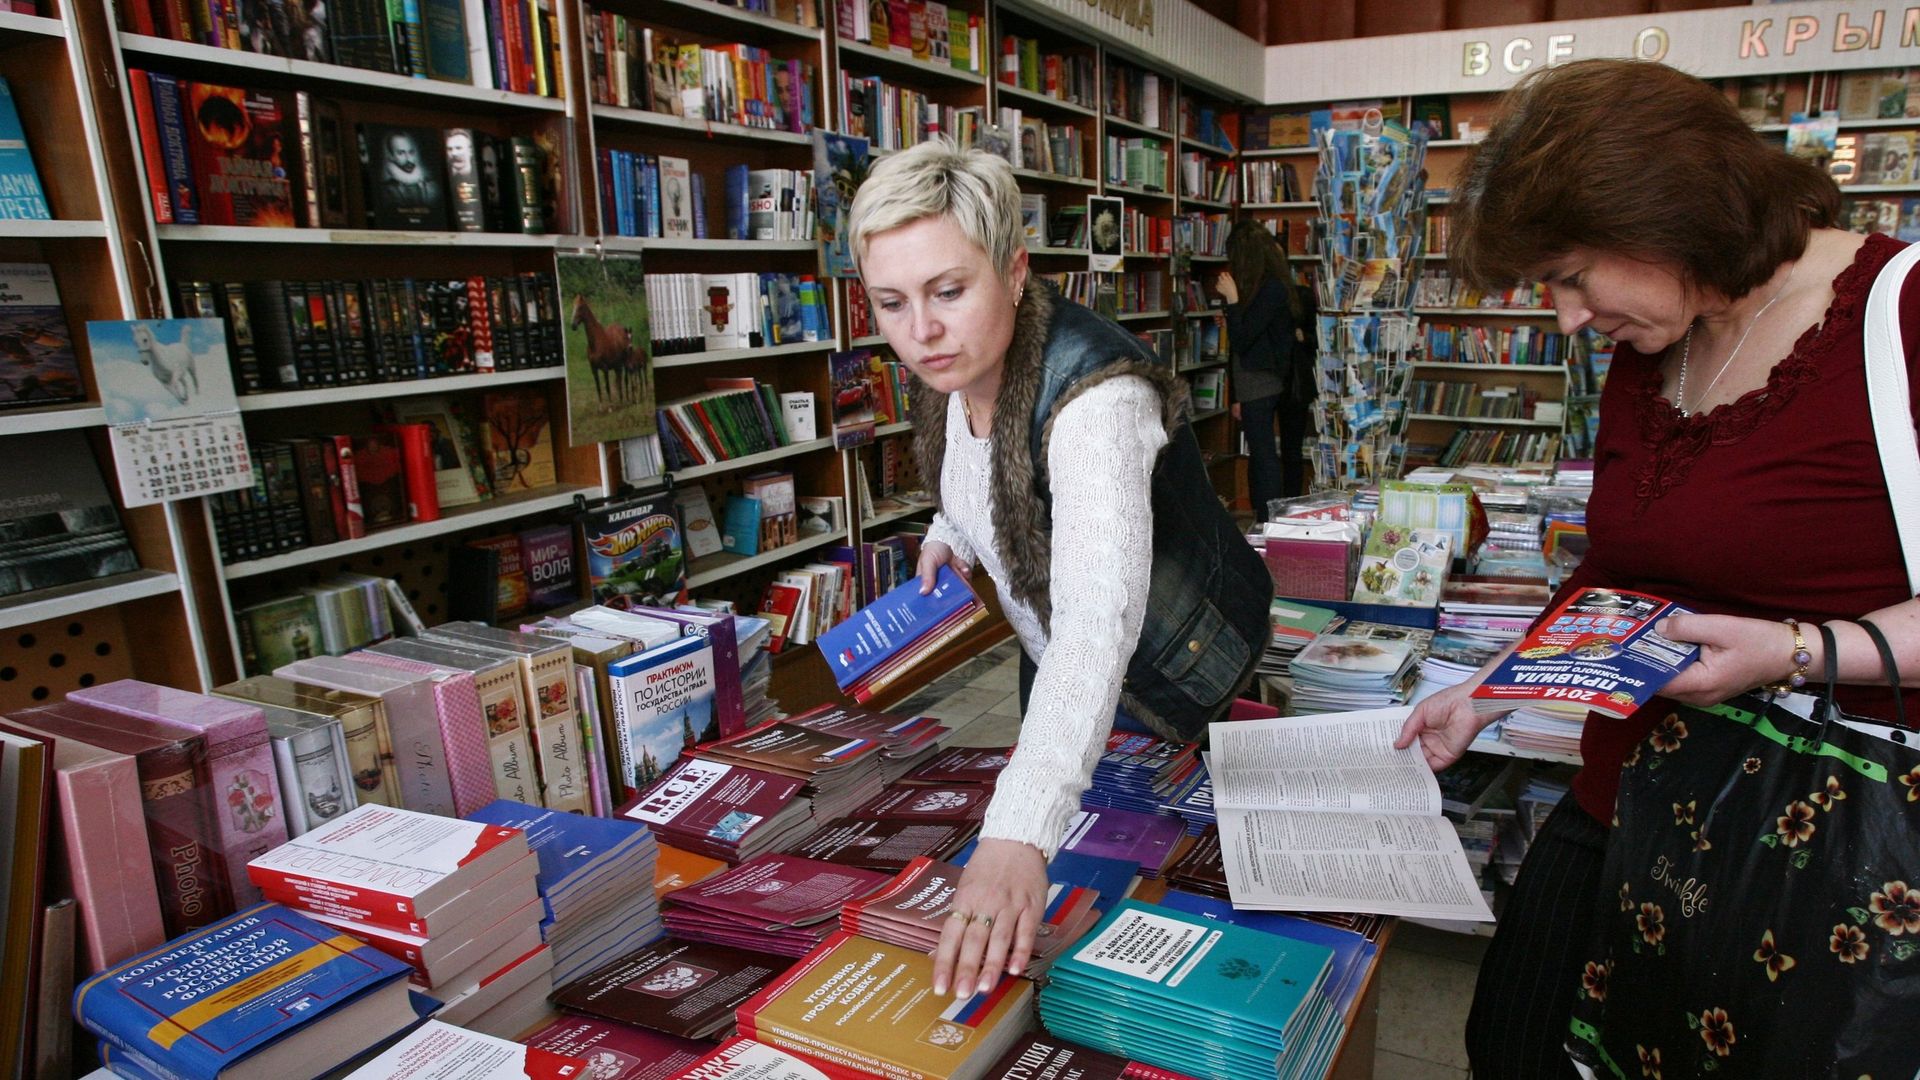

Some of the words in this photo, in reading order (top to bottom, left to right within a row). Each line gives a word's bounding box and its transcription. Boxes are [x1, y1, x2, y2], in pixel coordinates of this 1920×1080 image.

[1463, 33, 1575, 77] ВСЕ
[1634, 26, 1669, 63] О
[750, 200, 772, 212] SHO
[148, 467, 160, 475] 13
[163, 465, 176, 473] 14
[179, 462, 190, 471] 15
[208, 458, 219, 466] 17
[150, 455, 158, 464] 6
[205, 447, 217, 455] 10
[149, 478, 163, 487] 20
[165, 476, 177, 484] 21
[181, 473, 193, 481] 22
[196, 471, 208, 479] 23
[210, 468, 222, 477] 24
[152, 489, 165, 498] 27
[183, 484, 195, 492] 29
[198, 481, 210, 490] 30
[213, 479, 225, 487] 31
[608, 504, 653, 522] КАЛЕНДАР
[531, 545, 558, 564] МИР
[532, 557, 570, 582] ВОЛЯ
[634, 688, 653, 703] ПО
[655, 667, 706, 694] ИСТОРИИ
[646, 661, 694, 685] ПРАКТИКУМ
[1513, 672, 1619, 691] ПРАВИЛА
[1571, 666, 1645, 687] ДОРОЖНОГО
[637, 690, 682, 712] ГОСУДАРСТВА
[688, 680, 708, 692] ПРАВА
[656, 695, 692, 715] РОССИИ
[1543, 687, 1597, 701] 2014
[555, 723, 569, 760] Album
[505, 740, 521, 780] Album
[560, 764, 574, 798] Photo
[666, 772, 719, 813] ПЕНСИЯХ
[172, 841, 201, 917] Photo
[895, 876, 946, 910] СЕМЕЙНЫЙ
[917, 886, 957, 911] КОДЕКС
[117, 916, 261, 983] КОММЕНТАРИЙ
[1105, 915, 1144, 950] АДВОКАТСКОЙ
[1107, 922, 1149, 960] ДЕЯТЕЛЬНОСТИ
[1123, 926, 1157, 957] АДВОКАТУРЕ
[1133, 927, 1167, 961] РОССИЙСКОЙ
[142, 928, 267, 988] УГОЛОВНОМУ
[161, 938, 289, 1000] РОССИЙСКОЙ
[173, 942, 258, 983] КОДЕКСУ
[193, 949, 208, 957] К
[180, 946, 293, 1001] ФЕДЕРАЦИИ
[802, 952, 885, 1022] ПРОЦЕССУАЛЬНЫЙ
[803, 961, 857, 1004] УГОЛОВНО-
[839, 974, 877, 1005] КОДЕКС
[835, 991, 876, 1026] РОССИЙСКОЙ
[873, 963, 907, 993] ФЕДЕРАЦИИ
[543, 1024, 592, 1051] АЛЬНОЙ
[772, 1026, 880, 1066] УГОЛОВНО-ПРОЦЕССУАЛЬНЫЙ
[881, 1062, 909, 1077] КОДЕКС
[911, 1071, 923, 1080] РФ
[774, 1038, 884, 1077] УГОЛОВНО-ПРОЦЕССУАЛЬНЫЙ
